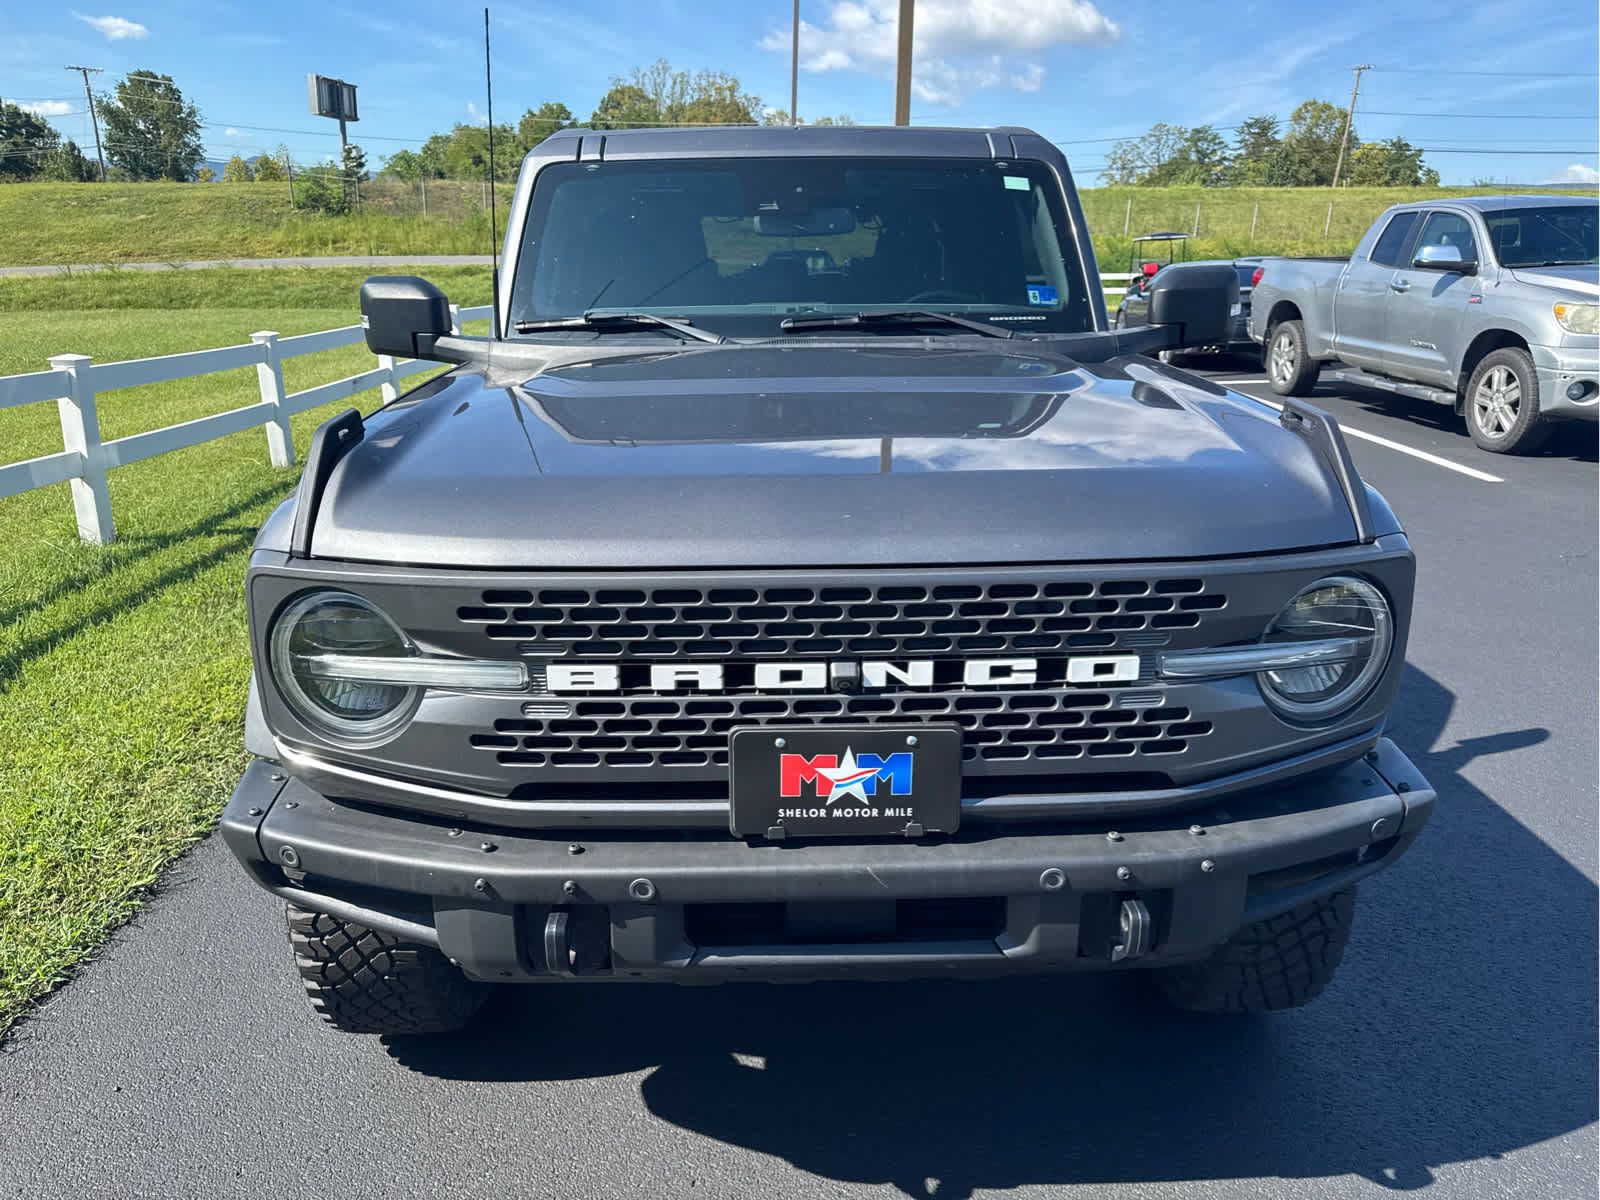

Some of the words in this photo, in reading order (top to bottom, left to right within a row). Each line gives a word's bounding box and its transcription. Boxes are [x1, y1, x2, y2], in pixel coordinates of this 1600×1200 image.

[546, 656, 1140, 690] BRONCO
[778, 808, 827, 818] SHELOR
[832, 808, 879, 817] MOTOR
[884, 807, 913, 817] MILE
